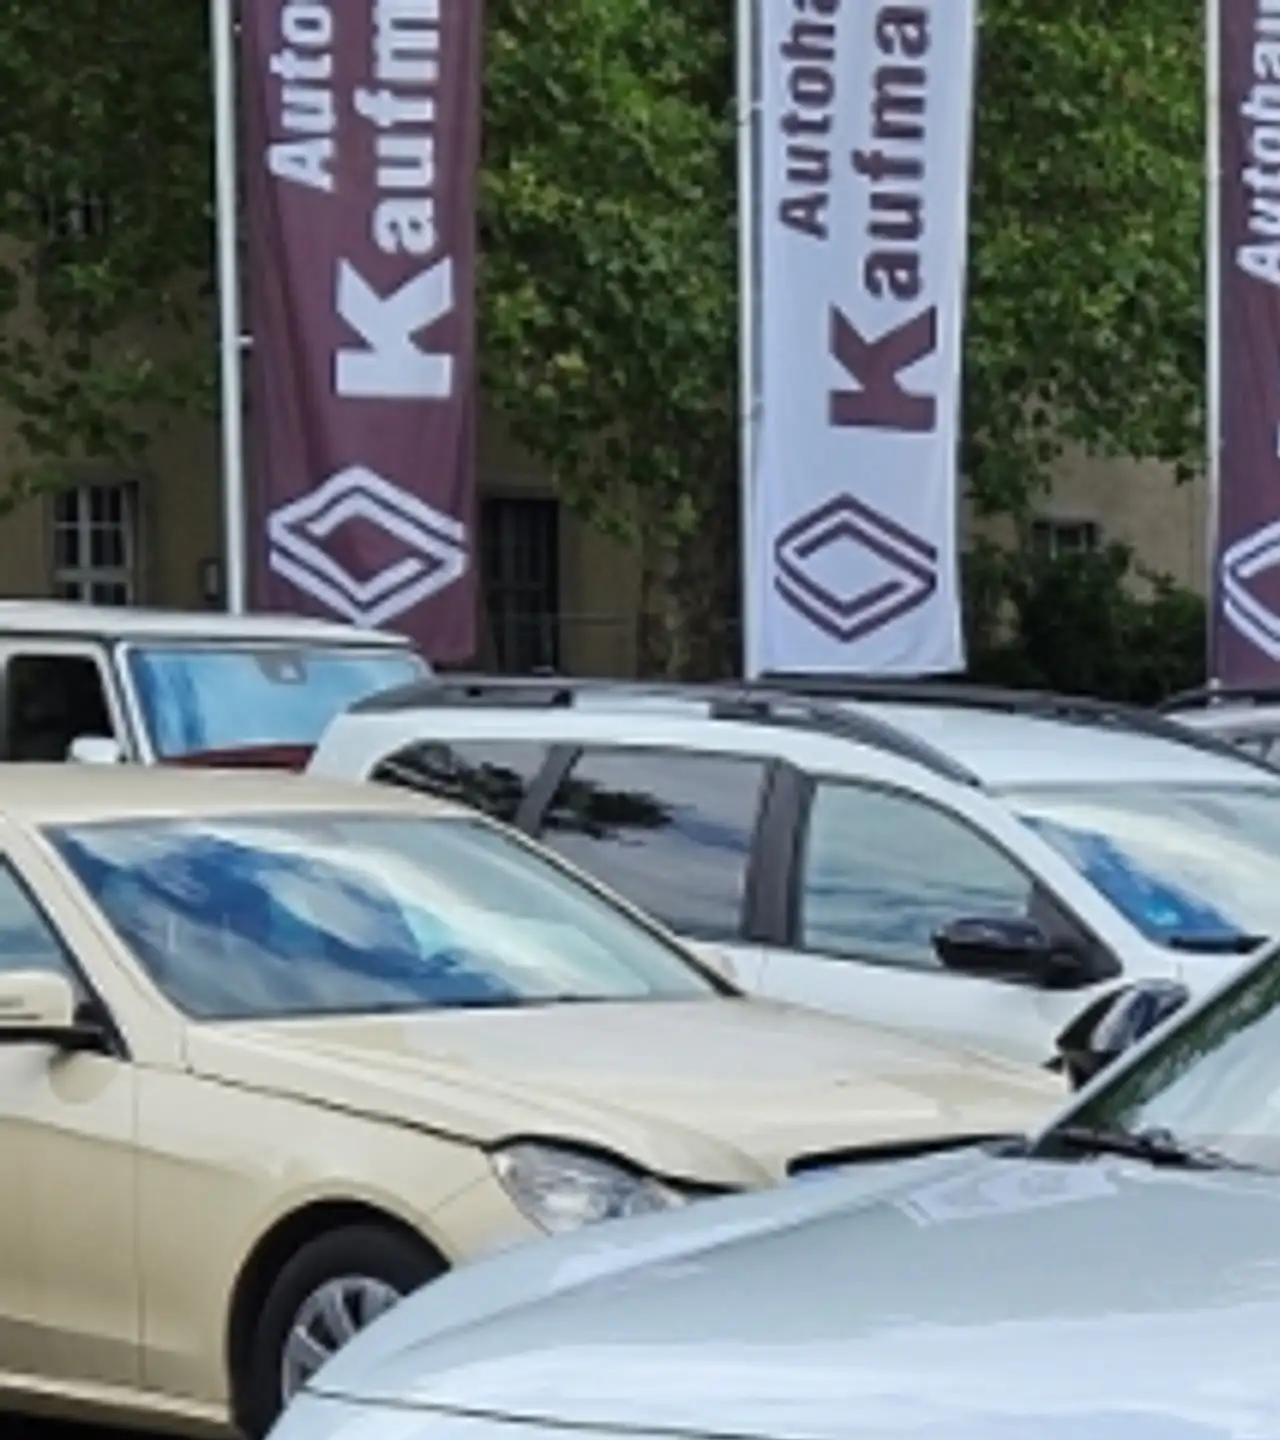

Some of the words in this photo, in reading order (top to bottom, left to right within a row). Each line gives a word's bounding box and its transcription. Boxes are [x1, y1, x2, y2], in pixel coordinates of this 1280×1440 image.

[267, 0, 335, 191] Auto
[335, 0, 455, 397] Kaufm
[826, 4, 938, 433] Kaufma
